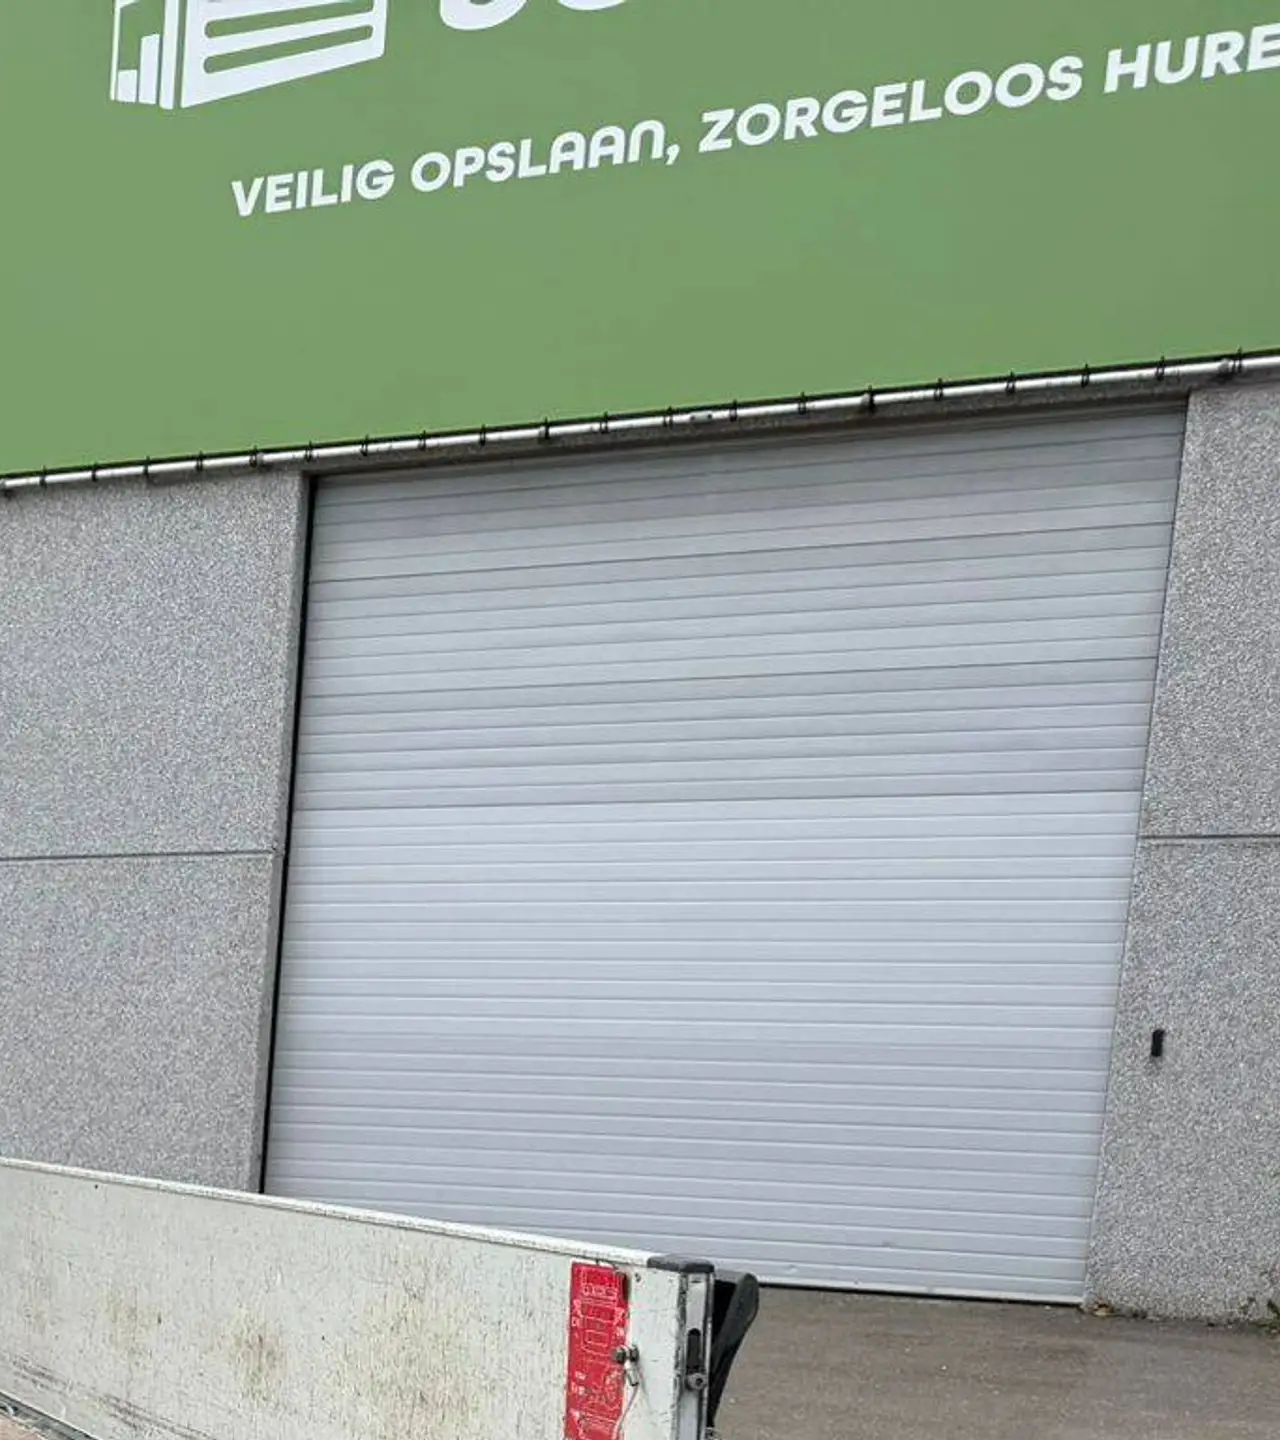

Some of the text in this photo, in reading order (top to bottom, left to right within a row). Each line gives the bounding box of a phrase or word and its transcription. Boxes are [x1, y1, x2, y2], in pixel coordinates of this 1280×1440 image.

[232, 159, 395, 217] VEILIG
[410, 119, 680, 192] OPSLAAN,
[699, 55, 1084, 153] ZORGELOOS
